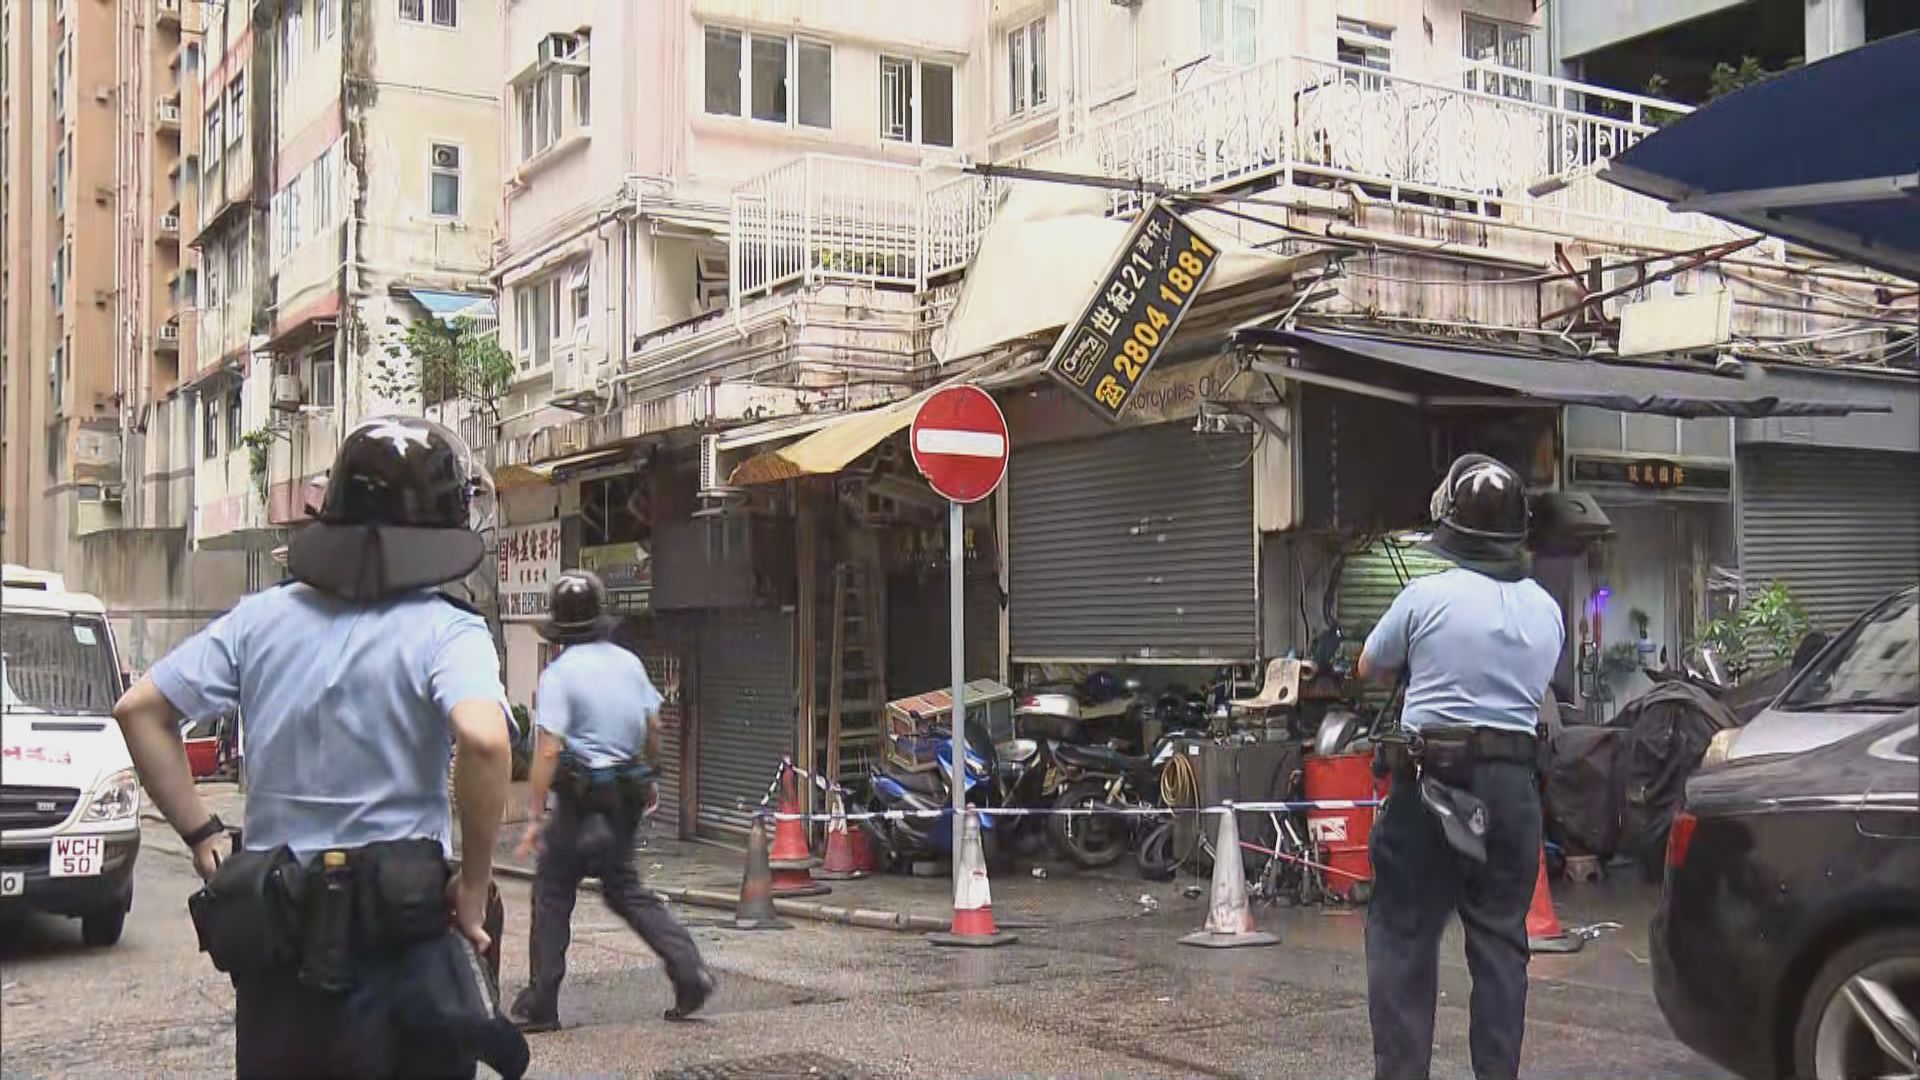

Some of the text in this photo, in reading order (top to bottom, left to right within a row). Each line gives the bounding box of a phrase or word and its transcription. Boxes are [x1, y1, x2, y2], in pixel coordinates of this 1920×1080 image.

[1090, 252, 1153, 336] 世紀21
[1113, 235, 1214, 383] 2804 1881
[1127, 382, 1196, 412] torcycles
[57, 838, 99, 856] WCH
[63, 857, 90, 874] 50
